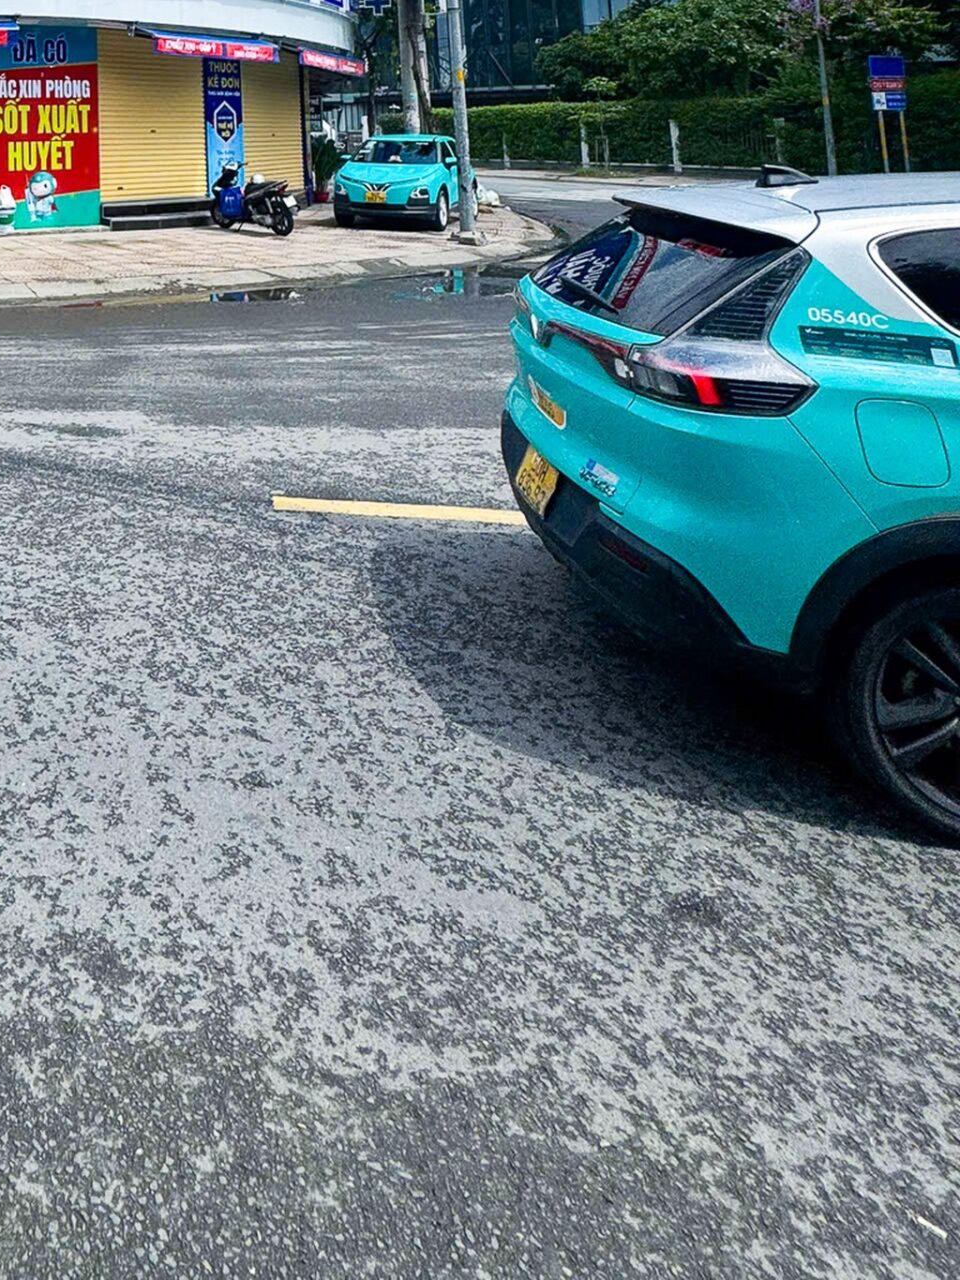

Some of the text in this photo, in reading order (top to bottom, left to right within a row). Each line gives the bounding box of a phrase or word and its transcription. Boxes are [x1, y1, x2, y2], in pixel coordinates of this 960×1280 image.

[13, 32, 68, 64] ĐÃ CÓ
[19, 79, 41, 98] XIN
[45, 75, 91, 98] PHÒNG
[37, 98, 91, 135] XUẤT
[7, 133, 74, 172] HUYẾT
[808, 307, 889, 329] 05540C
